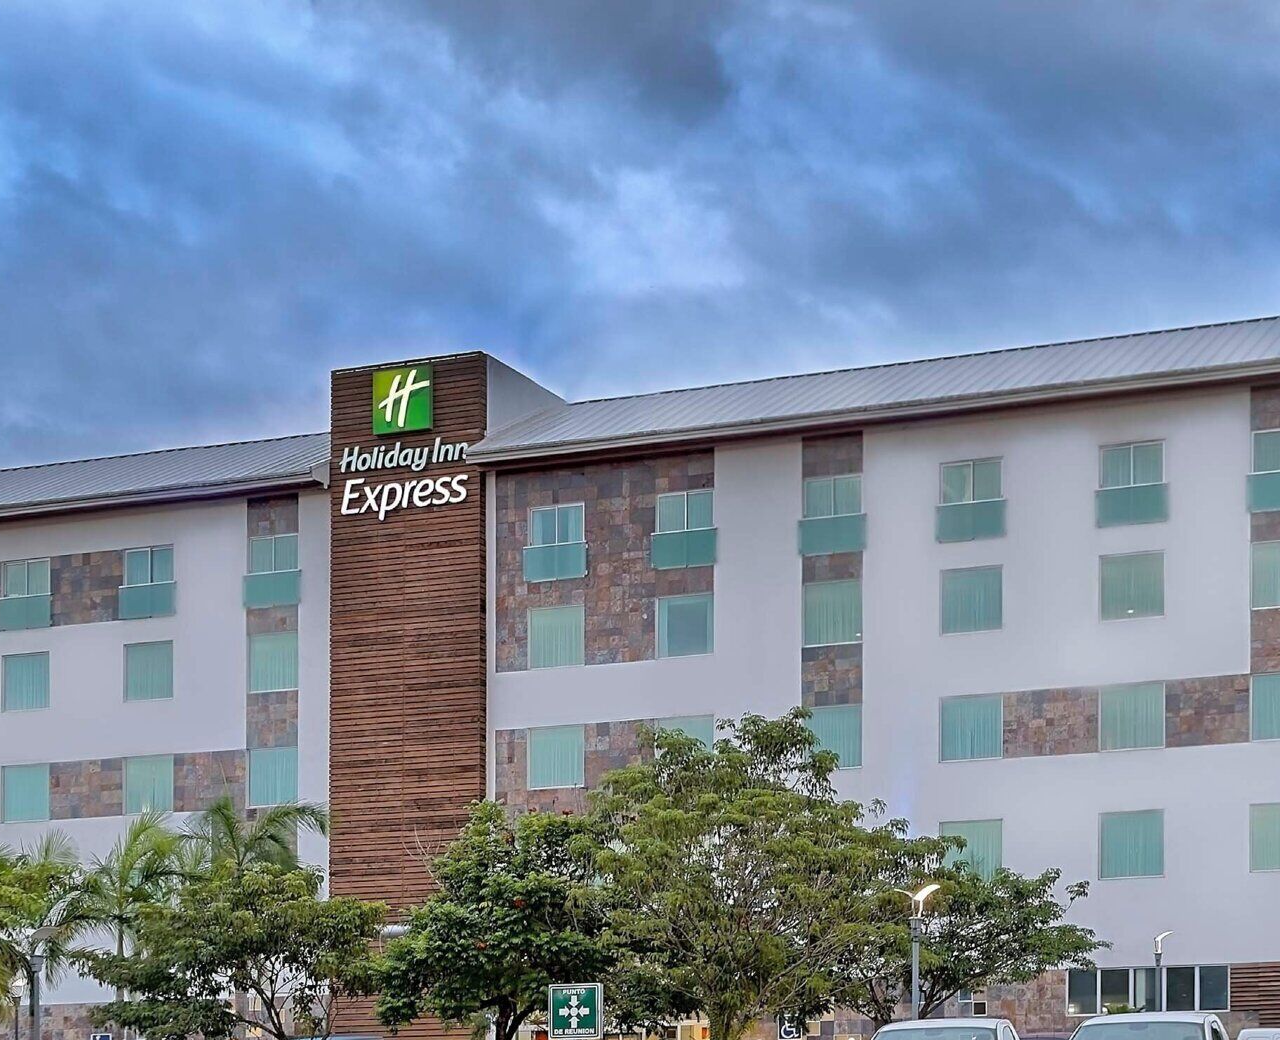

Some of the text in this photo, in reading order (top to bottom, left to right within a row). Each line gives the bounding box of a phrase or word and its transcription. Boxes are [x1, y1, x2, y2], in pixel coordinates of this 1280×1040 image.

[339, 437, 468, 473] Holiday Inn
[340, 474, 468, 521] Express
